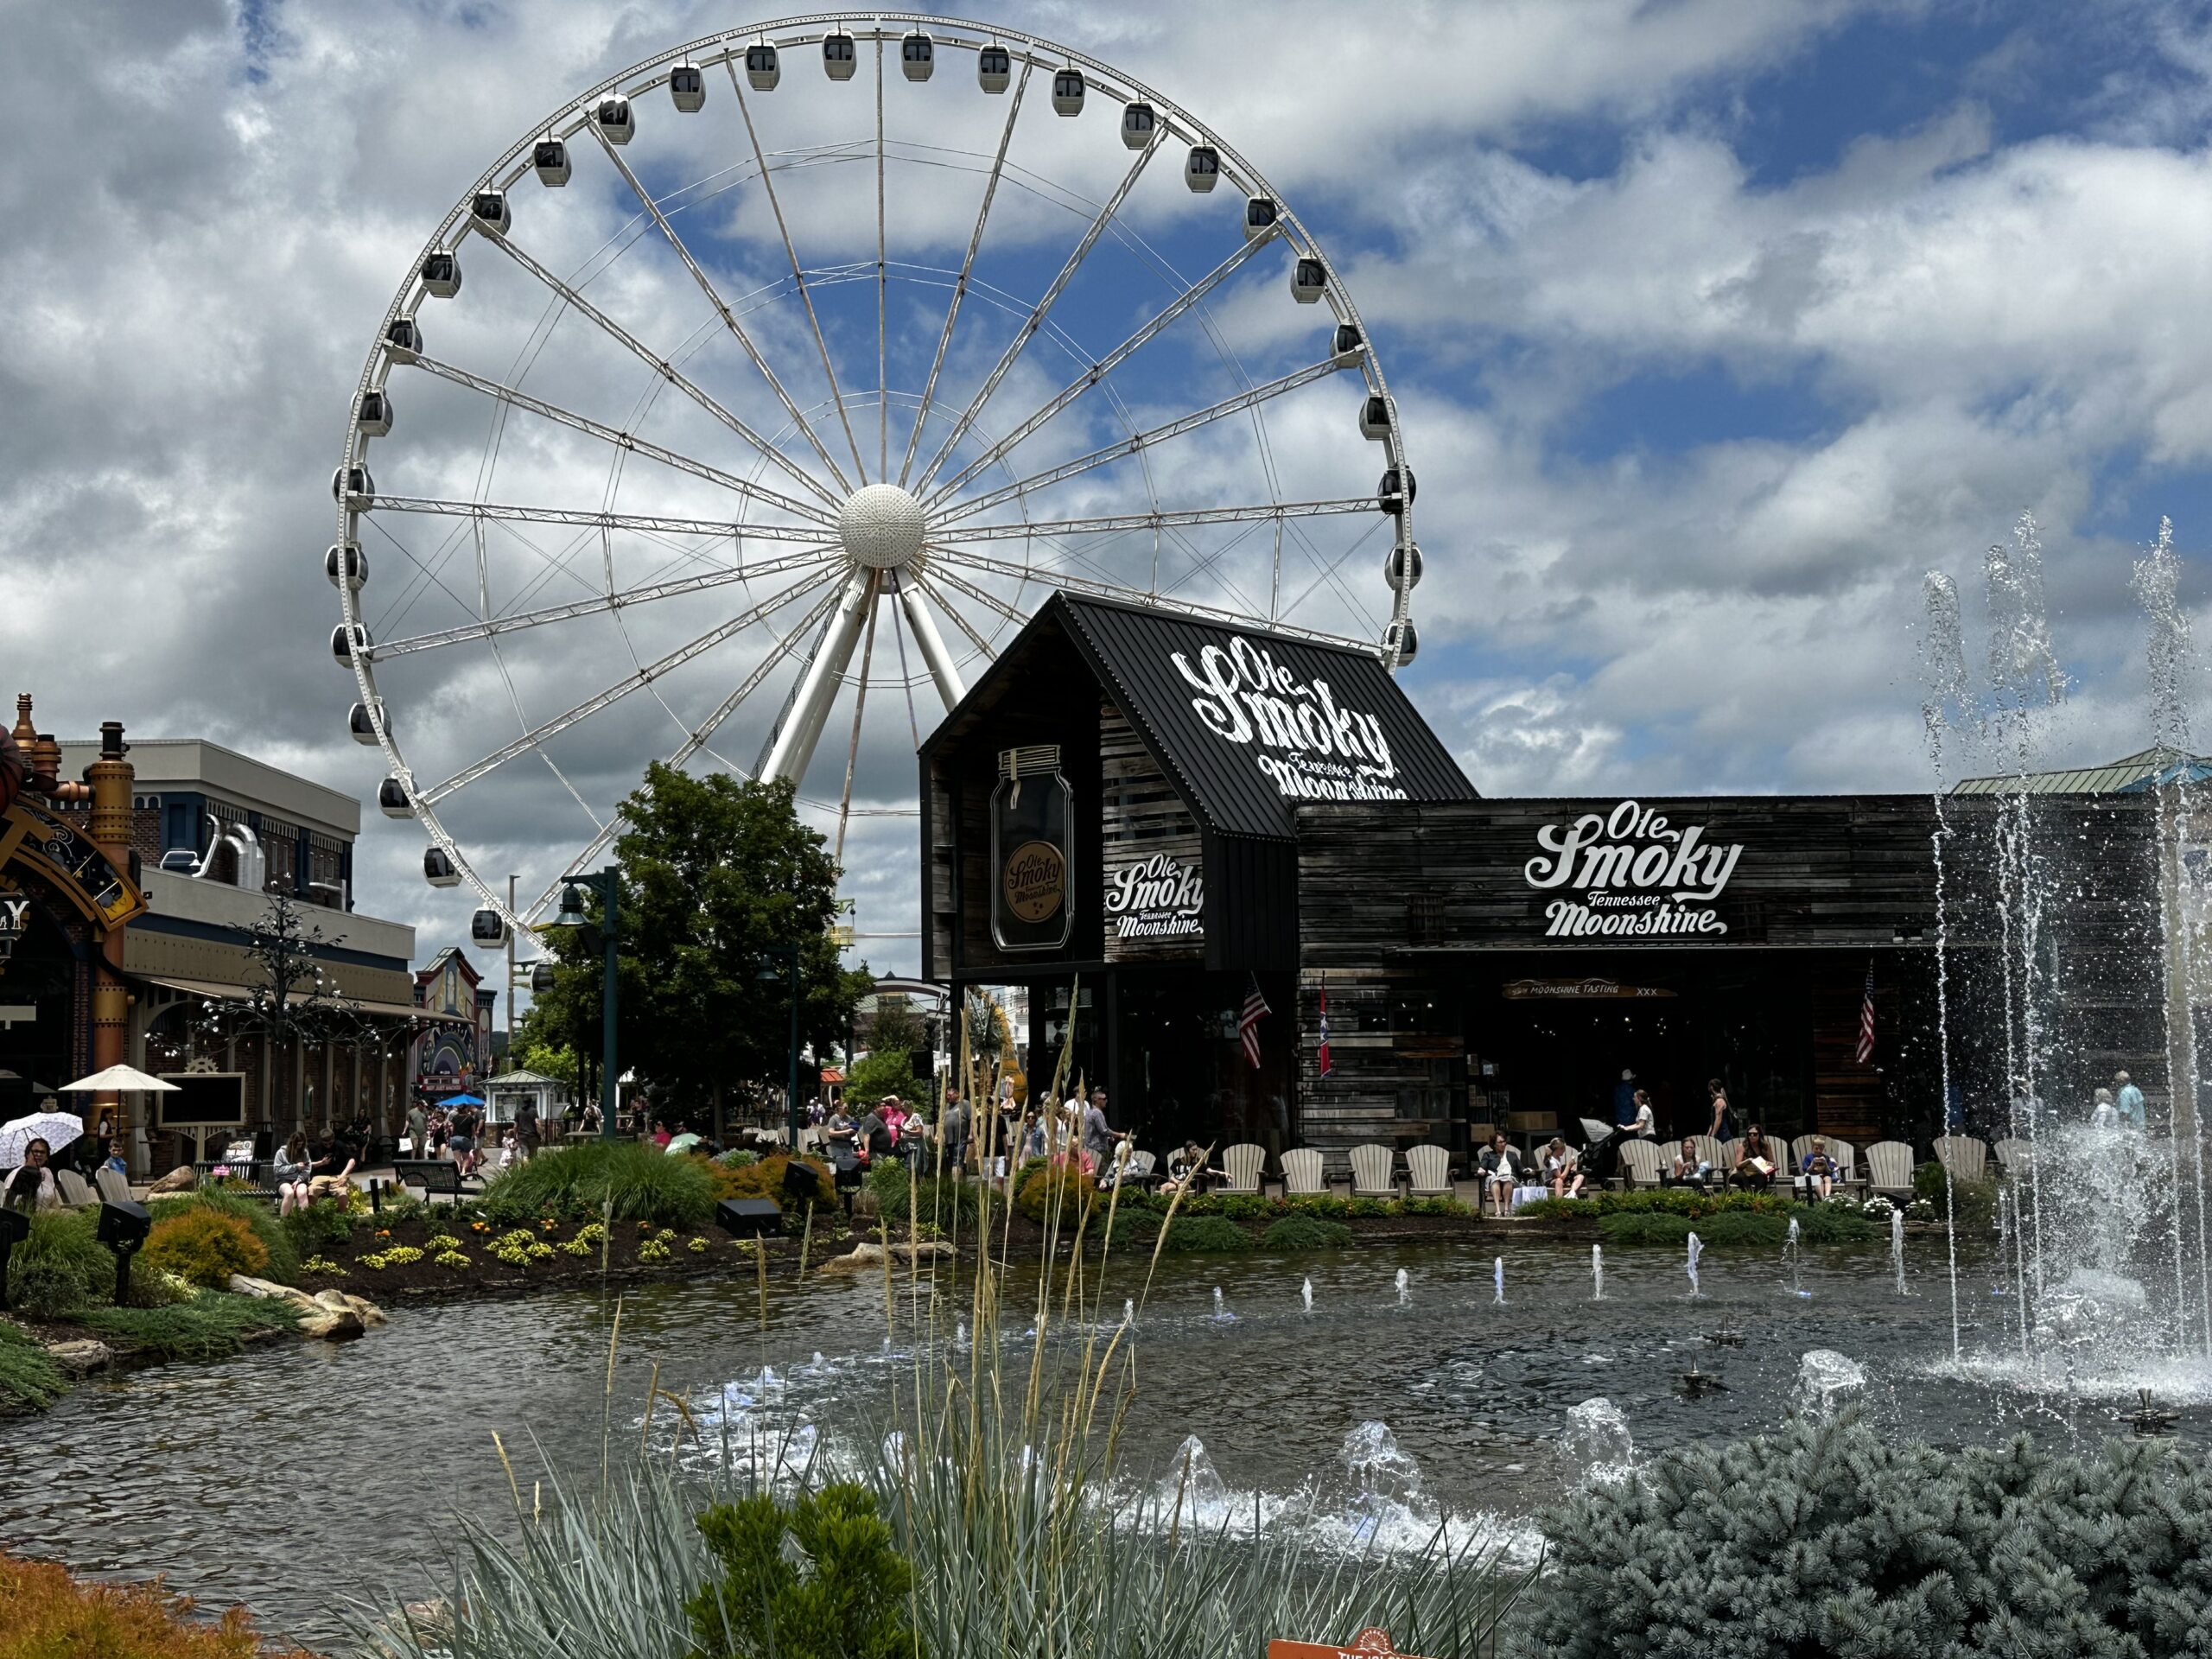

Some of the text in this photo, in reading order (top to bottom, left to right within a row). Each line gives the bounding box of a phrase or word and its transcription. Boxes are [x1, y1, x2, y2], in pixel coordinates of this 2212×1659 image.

[1230, 635, 1318, 702] Ole
[1170, 645, 1401, 779] Smoky
[1607, 799, 1681, 842] Ole
[1007, 857, 1060, 890] Smoky
[1027, 854, 1045, 869] Ole
[1147, 853, 1182, 879] Ole
[1524, 813, 1745, 904] Smoky
[1106, 862, 1204, 917] Smoky
[1587, 890, 1661, 907] Tennessee
[1116, 915, 1205, 938] Moonshine
[1545, 901, 1728, 937] Moonshine
[1583, 984, 1619, 994] TASTING
[1637, 988, 1657, 996] XXX
